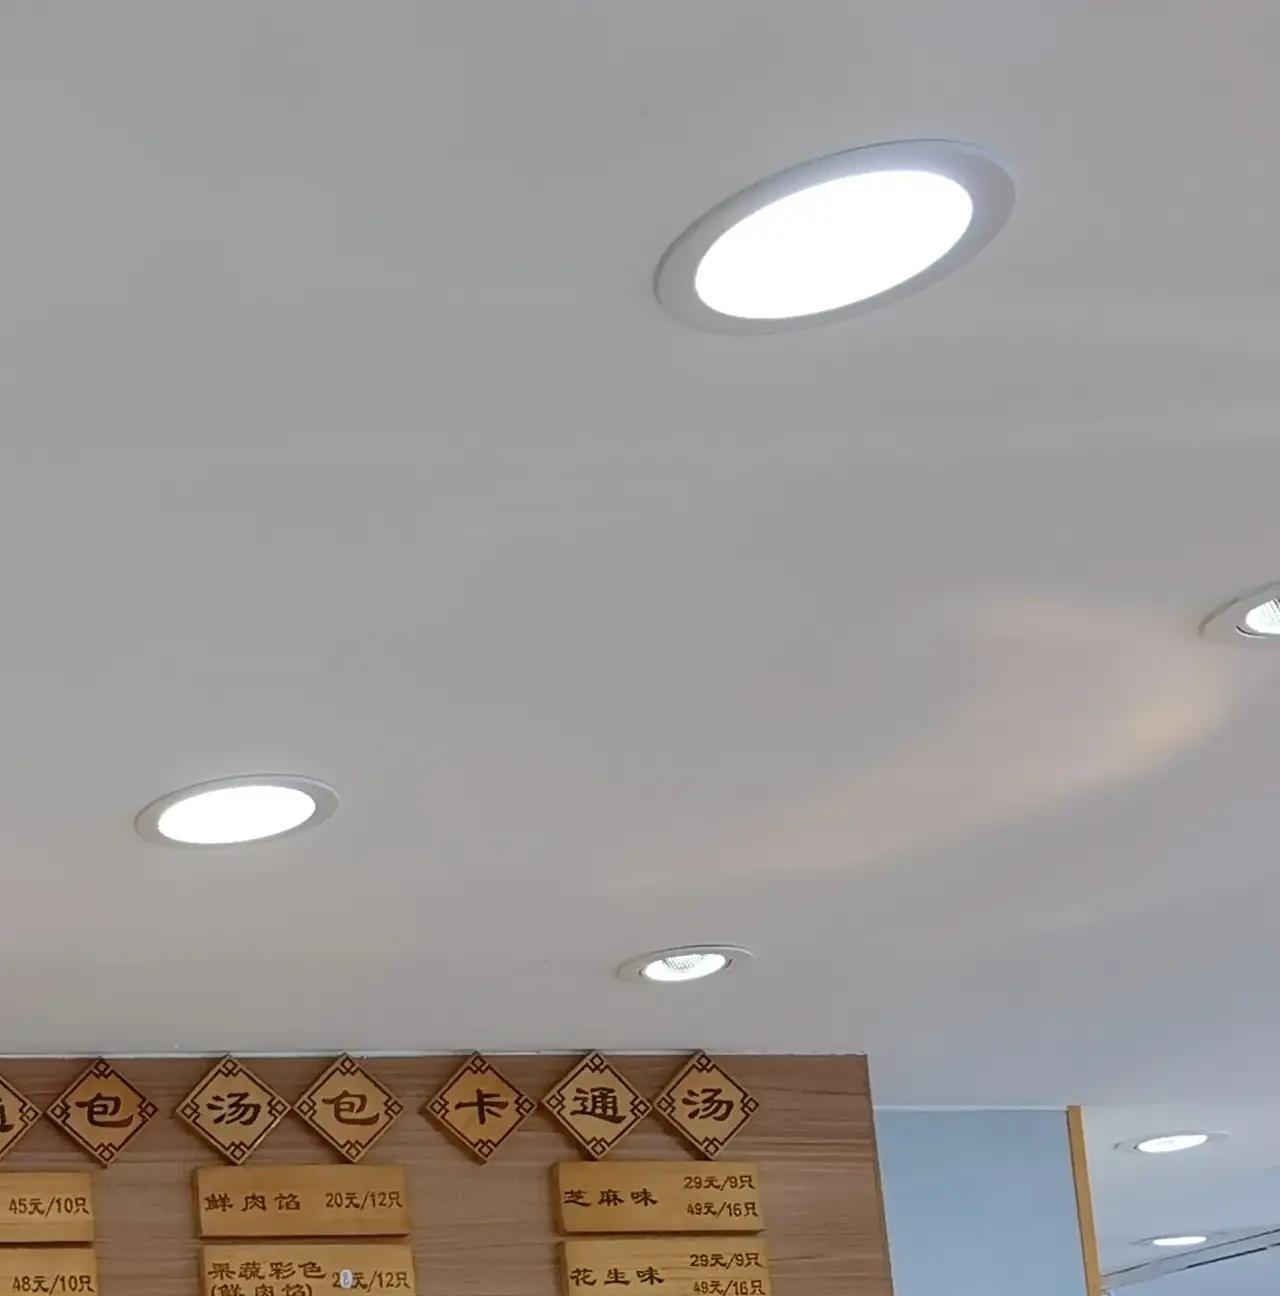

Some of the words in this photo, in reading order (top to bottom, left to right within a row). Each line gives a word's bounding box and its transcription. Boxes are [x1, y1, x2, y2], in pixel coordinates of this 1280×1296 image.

[207, 1090, 381, 1128] 汤包
[457, 1087, 735, 1124] 卡通汤
[684, 1175, 755, 1191] 29元/9只
[205, 1193, 300, 1212] 鲜肉馅
[326, 1191, 403, 1210] 20元/12只
[563, 1188, 658, 1207] 芝麻味
[9, 1198, 89, 1217] 45元/10只
[687, 1202, 758, 1217] 49元/16只
[690, 1252, 763, 1269] 29元/9只
[208, 1261, 326, 1280] 果蔬彩色
[570, 1266, 665, 1286] 花生味
[13, 1275, 95, 1294] 48元/10只
[694, 1280, 765, 1296] 49元/16只
